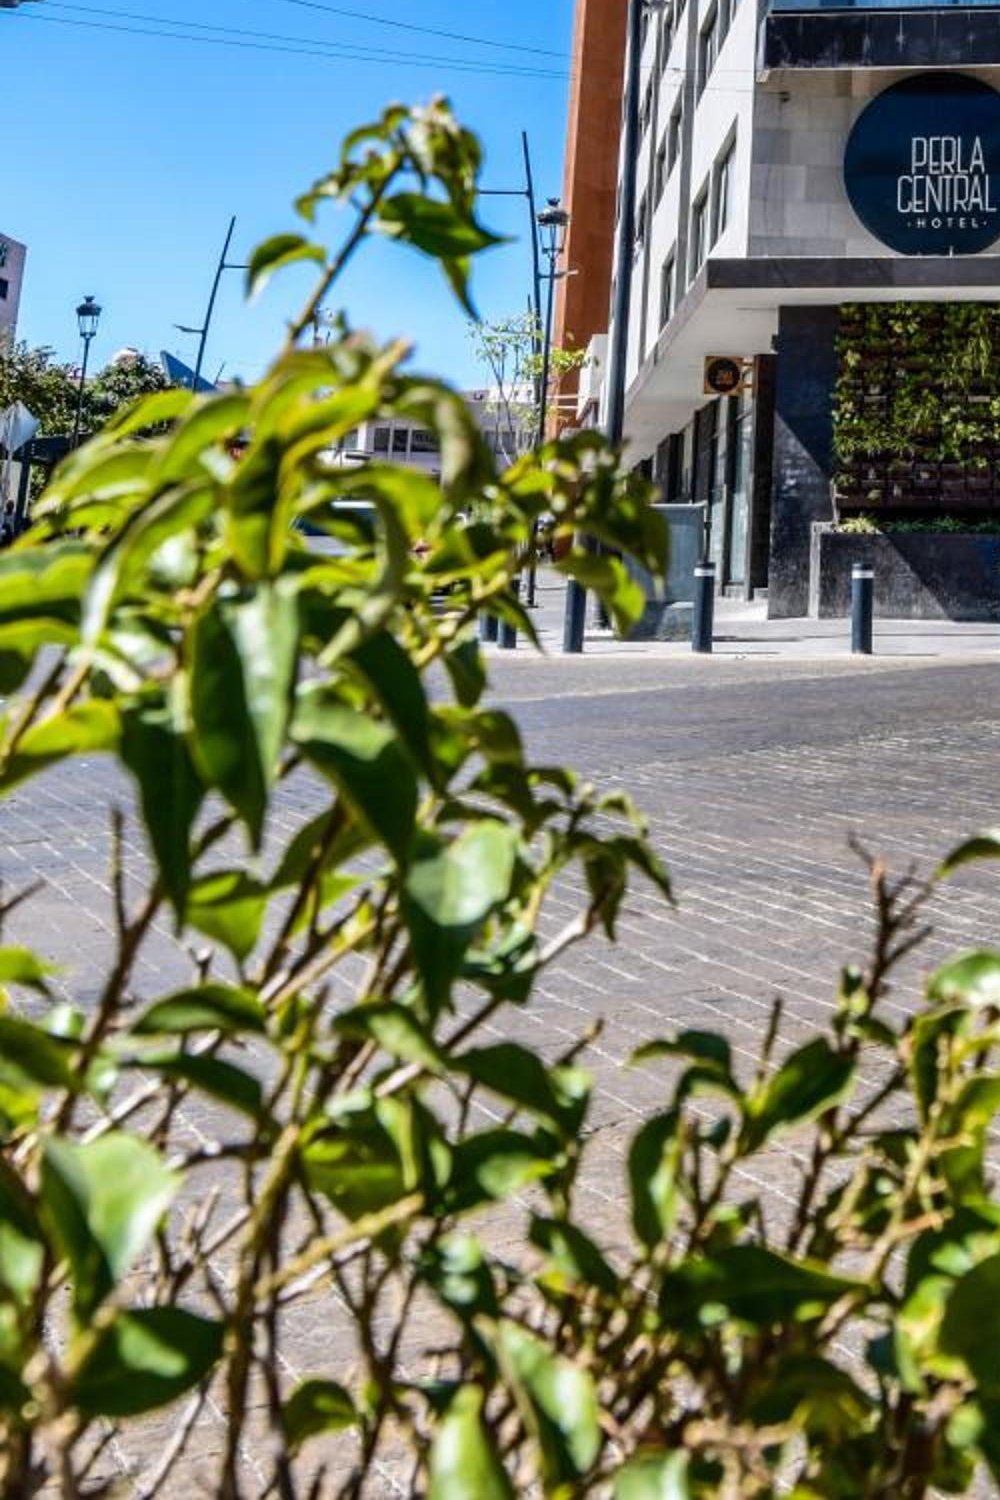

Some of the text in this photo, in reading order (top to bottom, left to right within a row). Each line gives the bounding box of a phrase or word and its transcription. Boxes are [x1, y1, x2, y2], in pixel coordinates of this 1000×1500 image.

[911, 136, 985, 174] PERLA
[897, 174, 997, 213] CENTRAL
[916, 217, 979, 229] HOTEL
